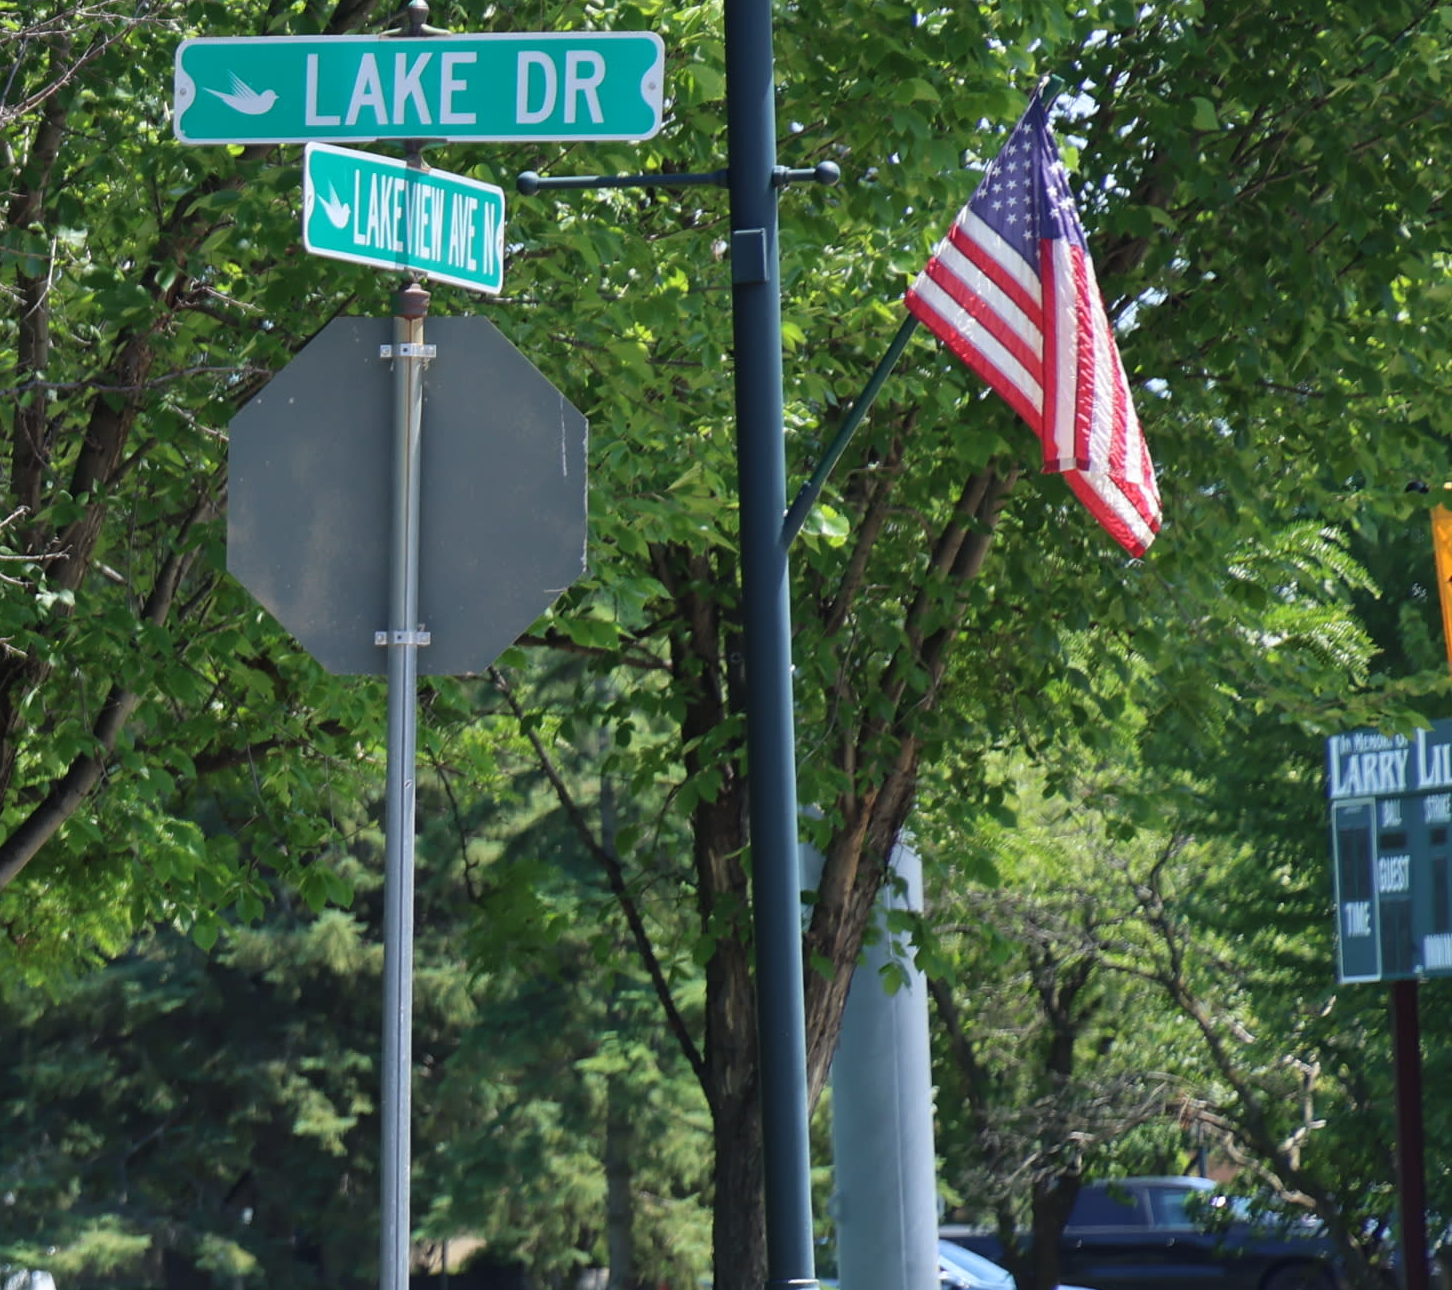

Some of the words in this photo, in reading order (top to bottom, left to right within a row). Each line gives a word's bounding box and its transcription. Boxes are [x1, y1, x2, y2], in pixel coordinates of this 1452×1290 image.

[305, 51, 477, 126] LAKE
[515, 49, 606, 125] DR
[353, 169, 445, 263] LAKEVIEW
[448, 192, 478, 272] AVE
[483, 201, 495, 277] N
[1328, 735, 1409, 800] LARRY
[1379, 855, 1411, 893] GUEST
[1345, 901, 1371, 938] TIME
